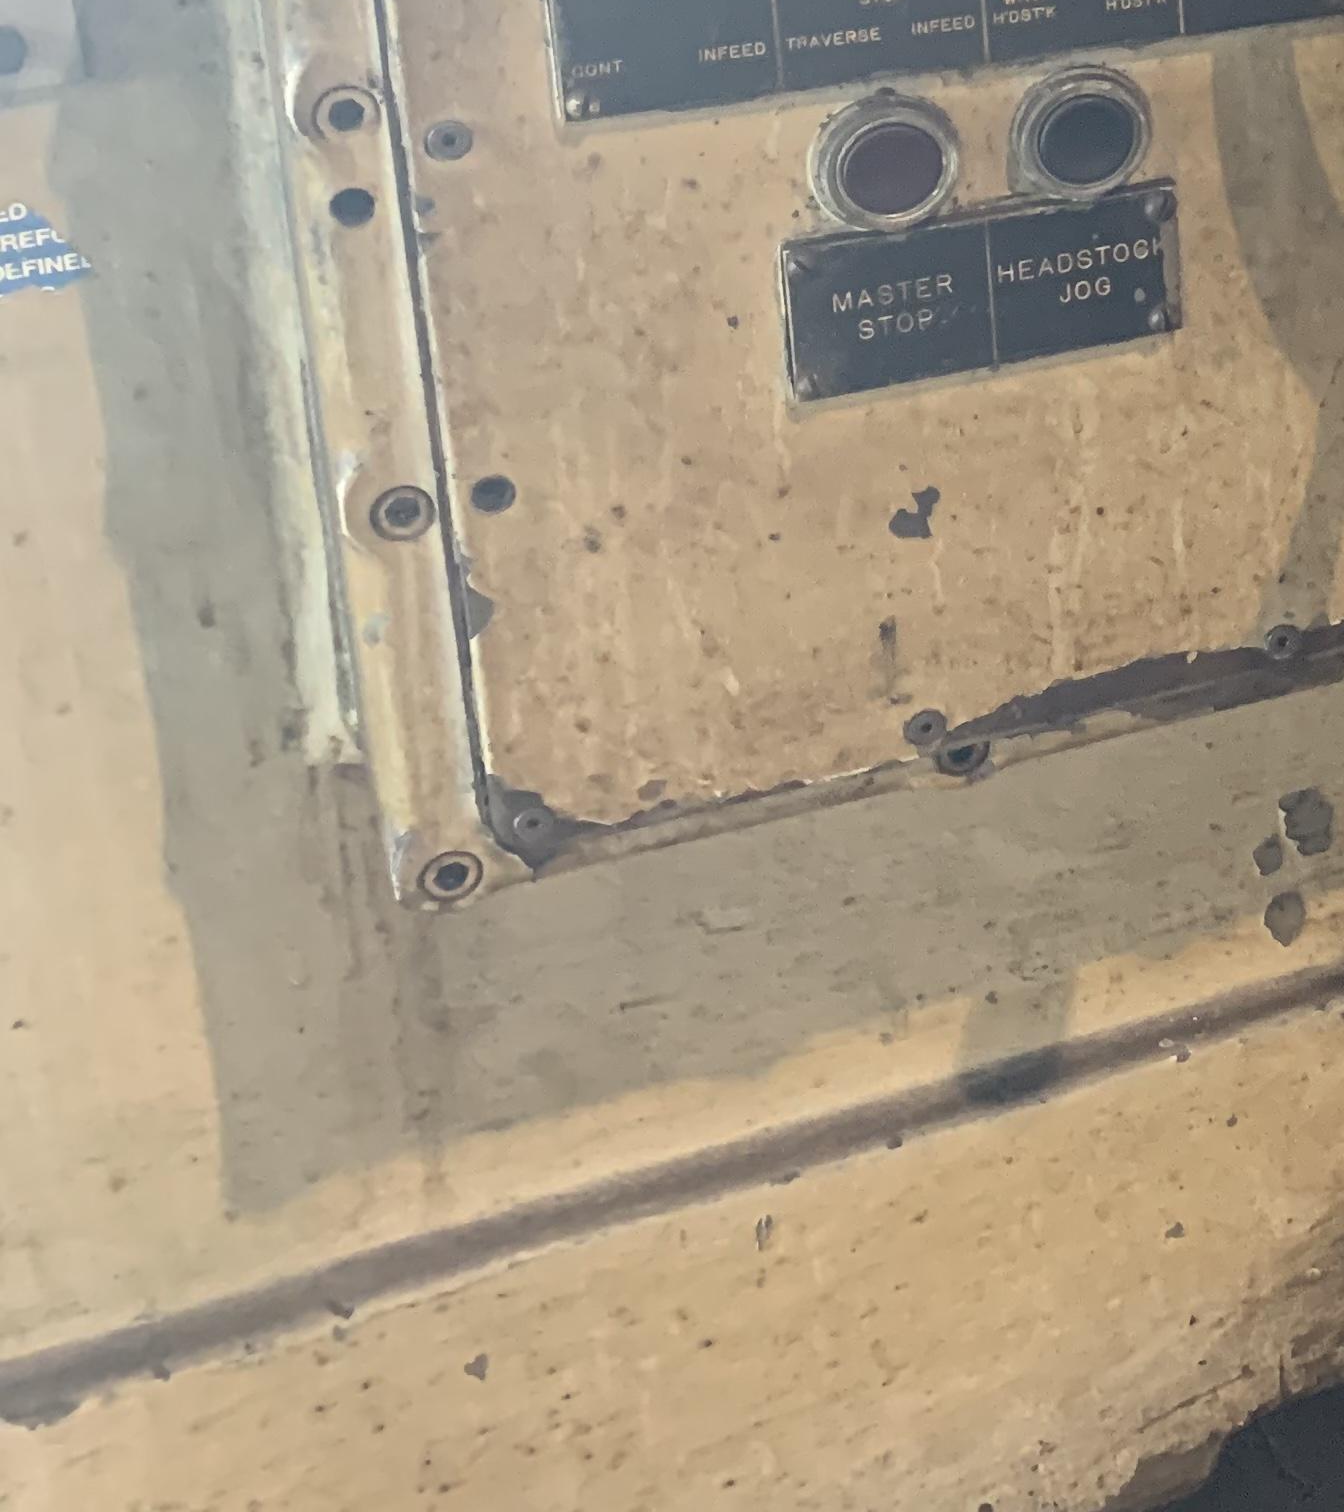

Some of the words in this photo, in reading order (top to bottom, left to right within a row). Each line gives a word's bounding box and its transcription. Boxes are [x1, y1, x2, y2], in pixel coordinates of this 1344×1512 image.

[785, 26, 883, 52] TRAVERSE
[910, 14, 976, 36] INFEED
[697, 40, 767, 65] INFEED
[832, 273, 955, 314] MASTER
[1059, 276, 1112, 304] JOG
[857, 308, 936, 341] STOP
